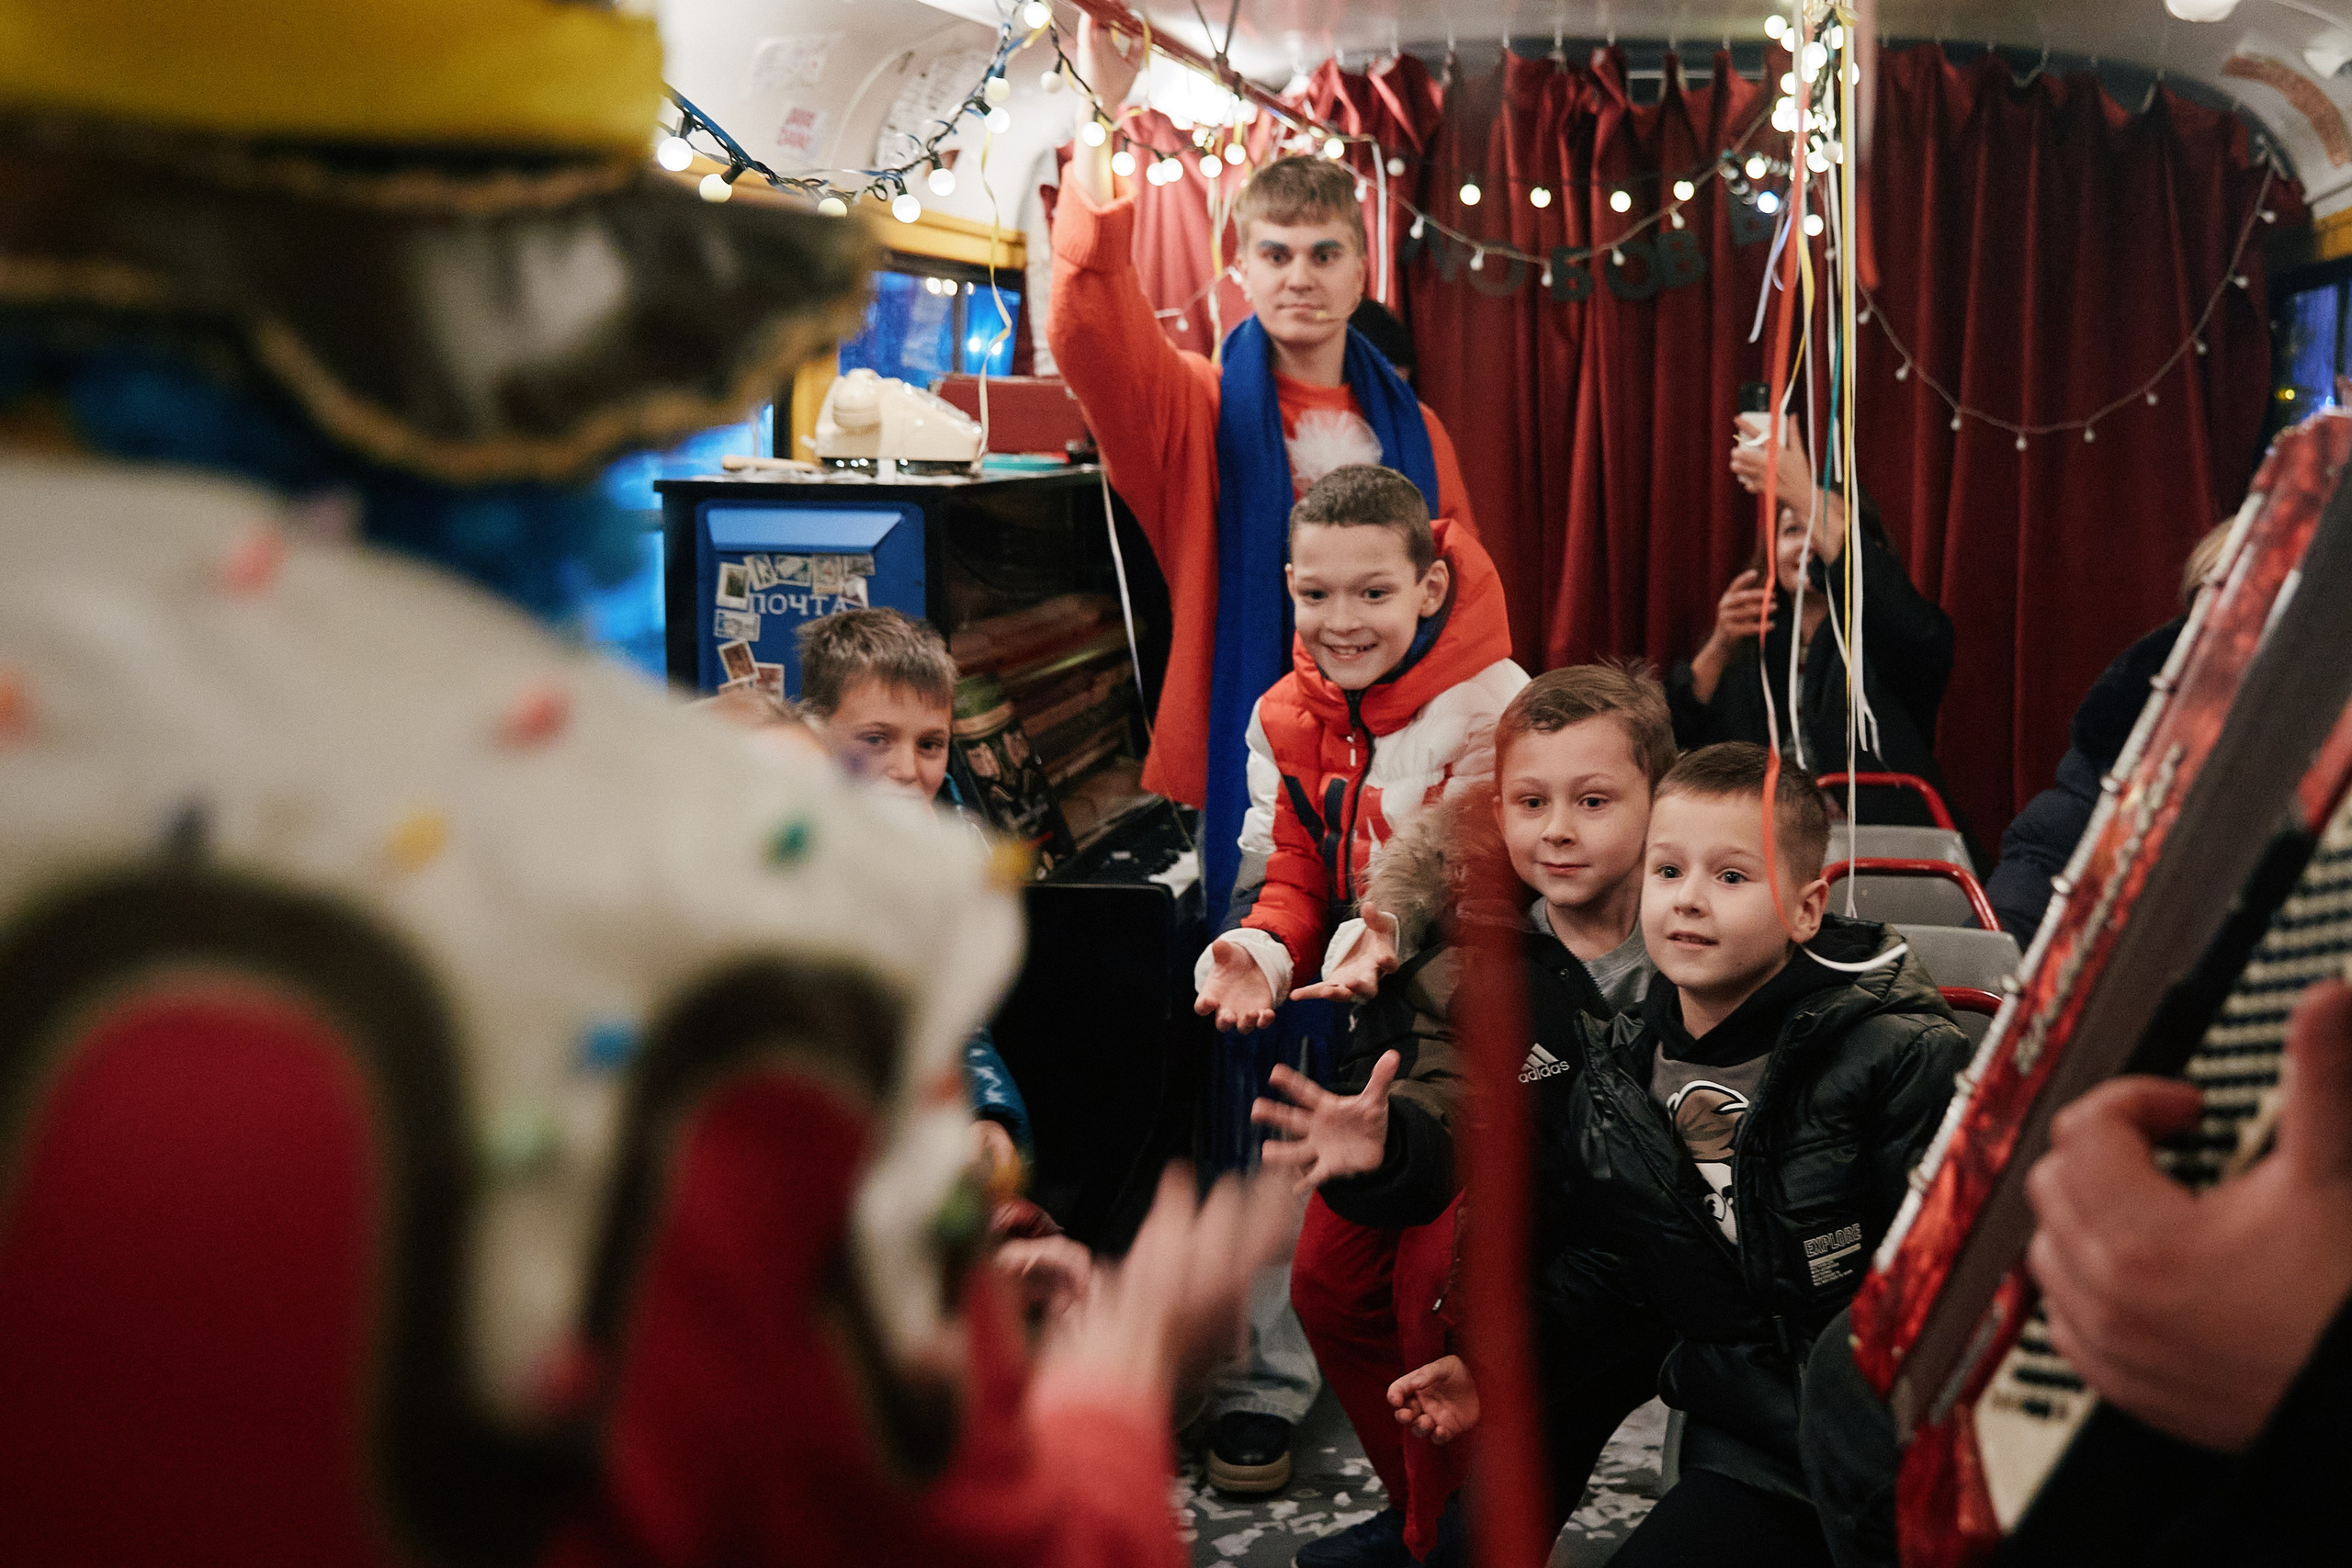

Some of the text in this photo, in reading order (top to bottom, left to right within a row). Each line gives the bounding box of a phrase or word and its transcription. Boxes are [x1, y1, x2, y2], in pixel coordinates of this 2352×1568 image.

[748, 592, 848, 617] ПОЧТА
[1518, 1060, 1571, 1083] adidas
[1804, 1223, 1862, 1258] EXPLORE
